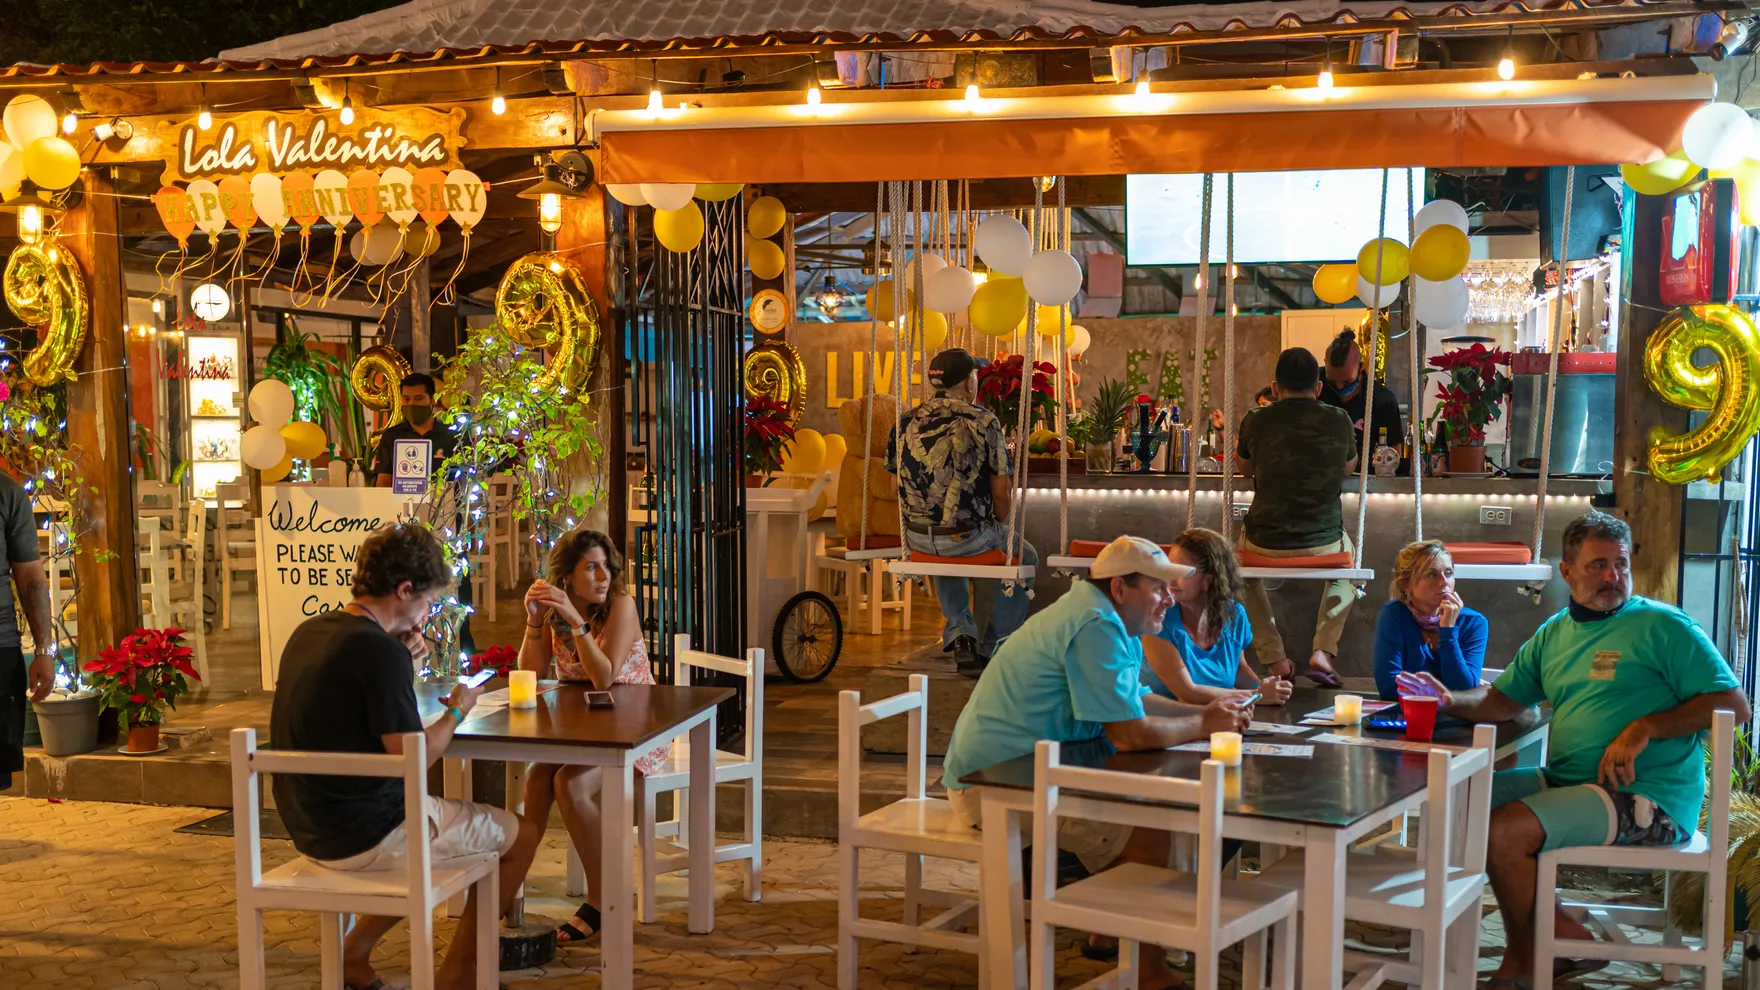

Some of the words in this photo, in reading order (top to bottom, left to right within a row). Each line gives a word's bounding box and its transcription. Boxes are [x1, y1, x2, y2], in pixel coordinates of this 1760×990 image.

[183, 126, 256, 173] Lola
[268, 119, 445, 167] Valentina
[162, 190, 254, 223] HAPPY
[282, 182, 482, 218] ANNIVERSARY
[157, 348, 231, 381] Valentina
[826, 351, 922, 408] LIVE
[1127, 348, 1218, 410] EAT
[267, 500, 380, 533] Welcome
[277, 544, 336, 563] PLEASE
[278, 568, 300, 585] TO
[308, 568, 328, 586] BE
